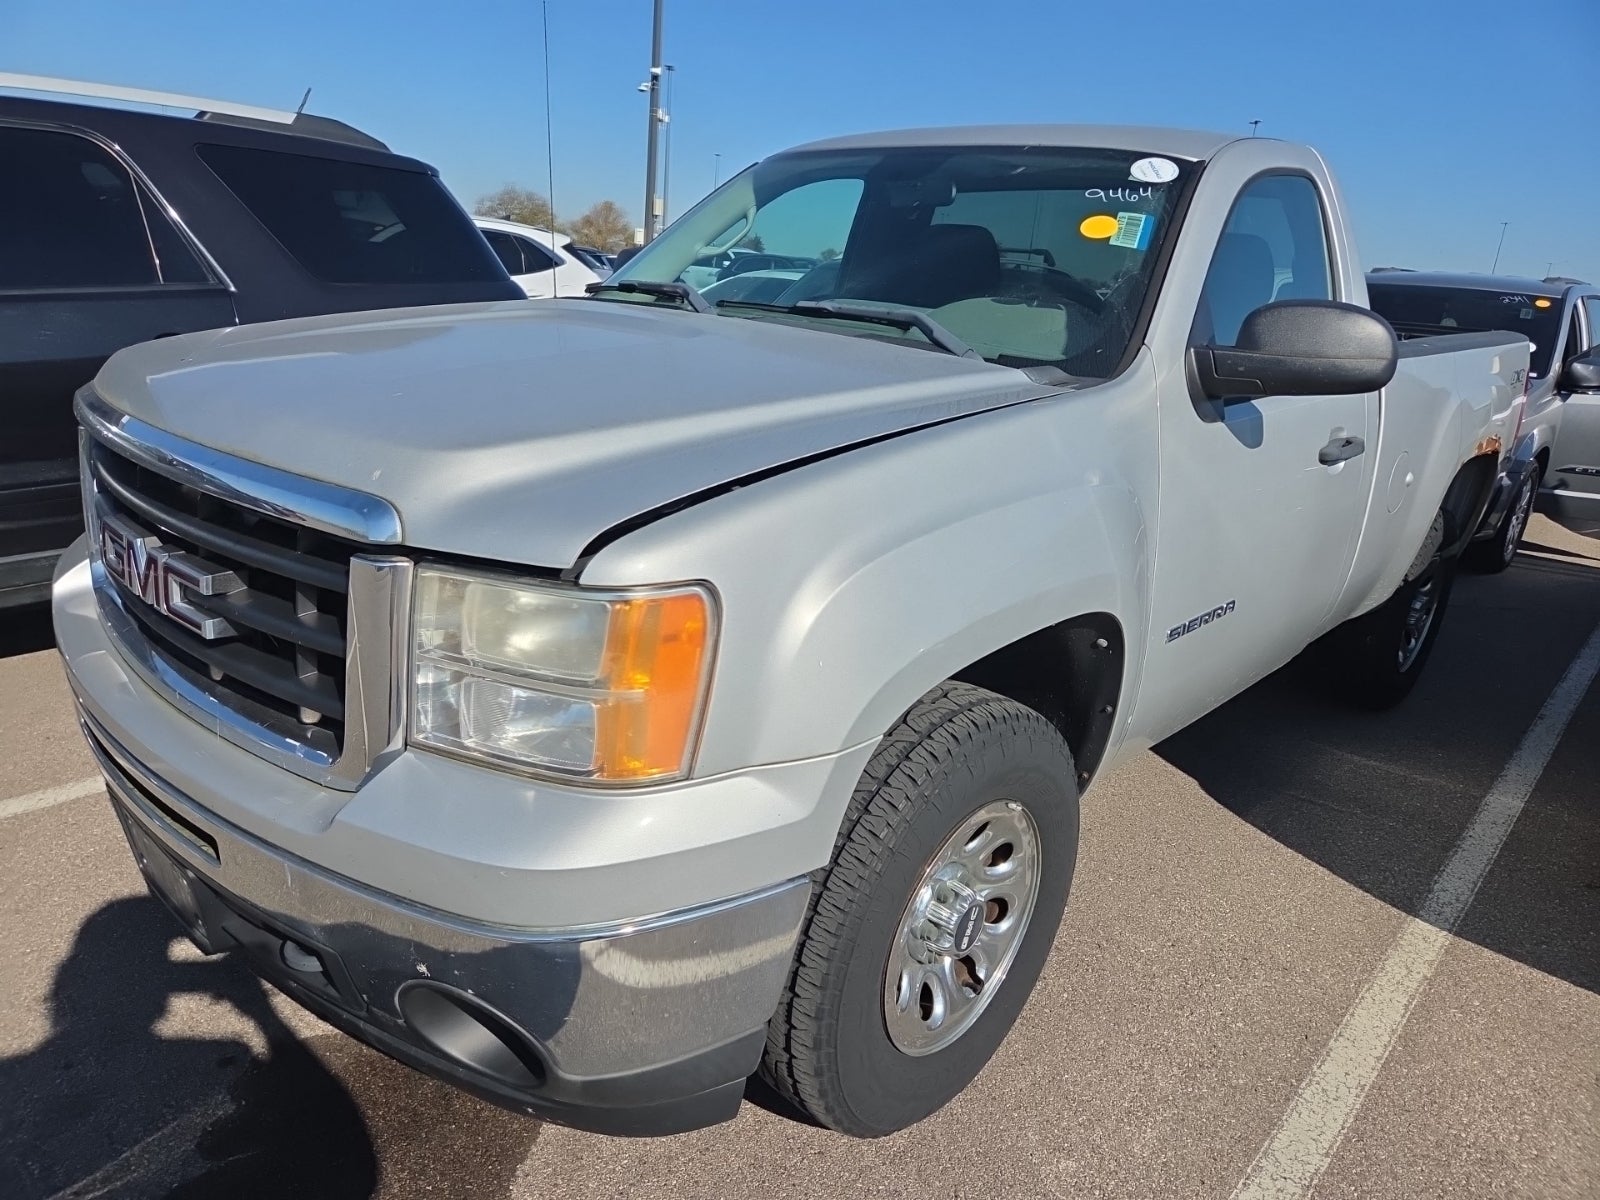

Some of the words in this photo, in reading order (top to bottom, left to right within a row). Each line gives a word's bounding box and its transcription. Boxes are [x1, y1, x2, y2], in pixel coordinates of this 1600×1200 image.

[1084, 186, 1153, 202] 9464
[101, 515, 240, 640] GMC
[1165, 599, 1236, 645] SIERRA
[960, 906, 979, 950] GMC
